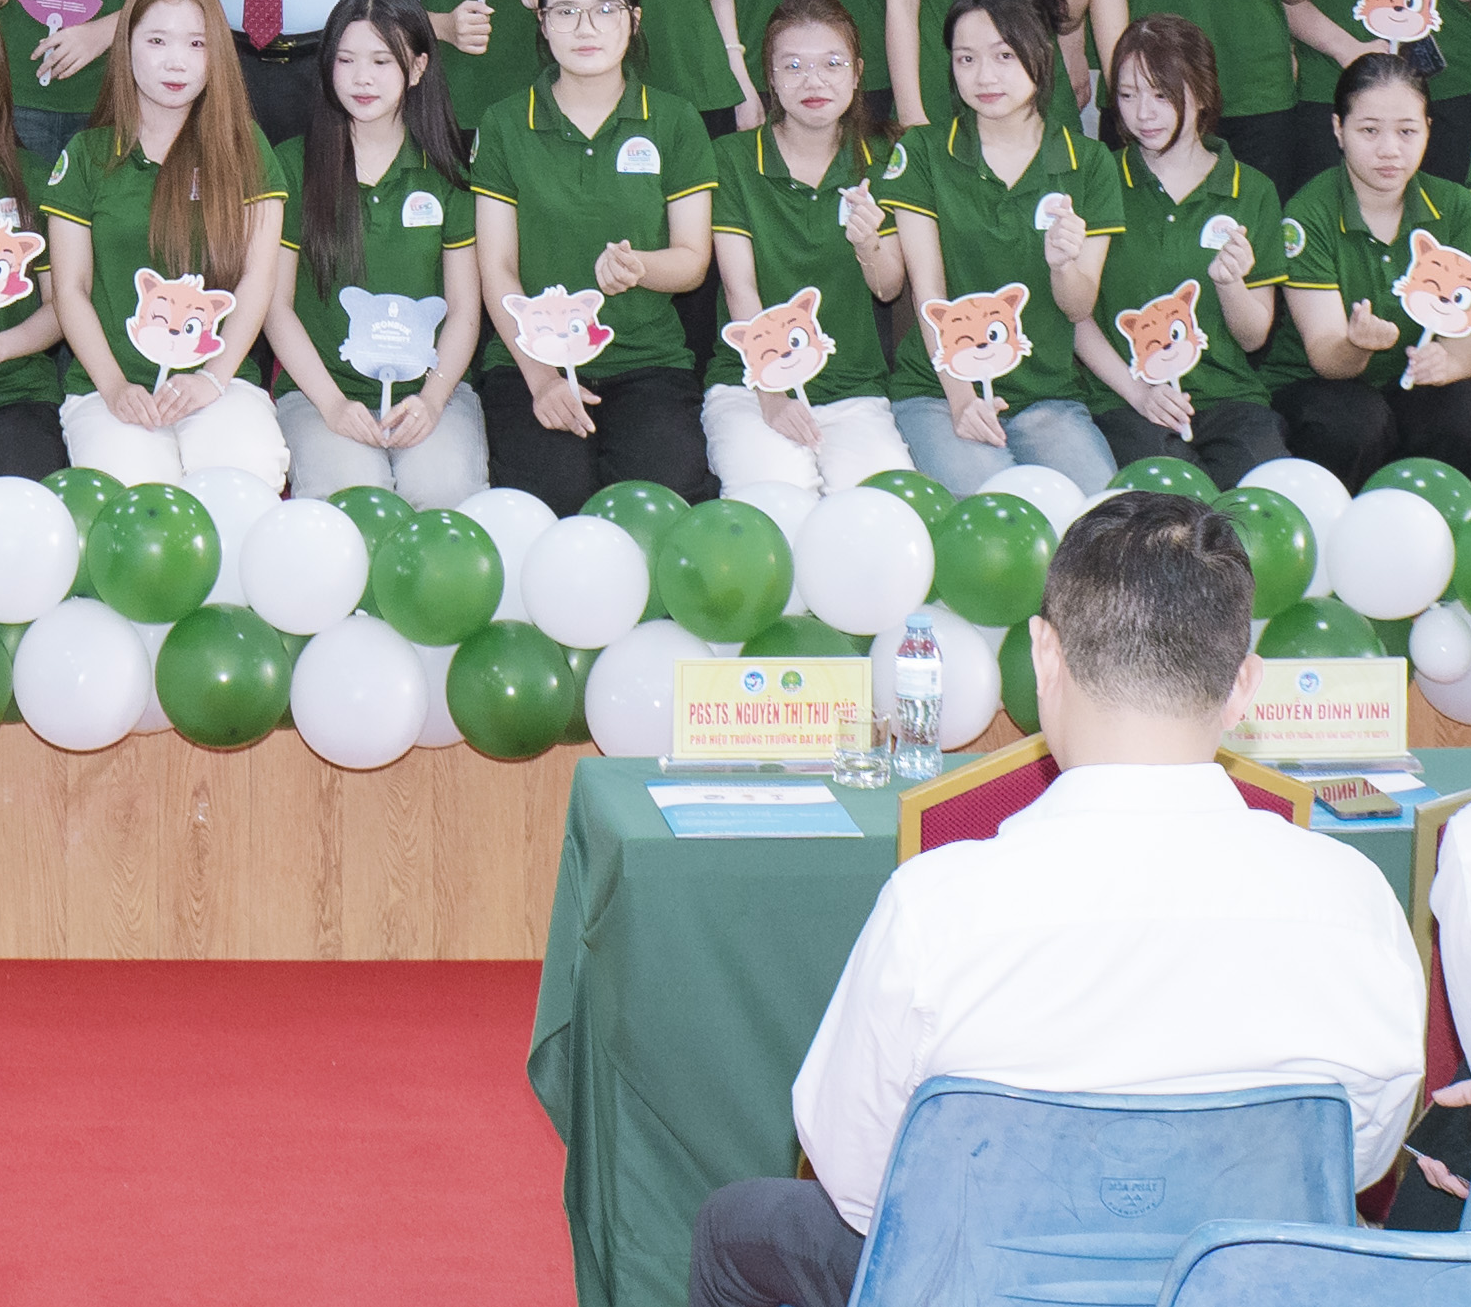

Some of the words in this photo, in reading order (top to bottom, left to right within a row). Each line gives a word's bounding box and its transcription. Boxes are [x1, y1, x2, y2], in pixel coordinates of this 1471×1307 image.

[688, 701, 732, 726] PGS.TS.
[735, 695, 780, 725] NGUYỄN
[784, 702, 804, 730] THỊ
[807, 702, 830, 725] THU
[1317, 698, 1352, 721] ĐÌNH
[1357, 702, 1391, 720] VINH
